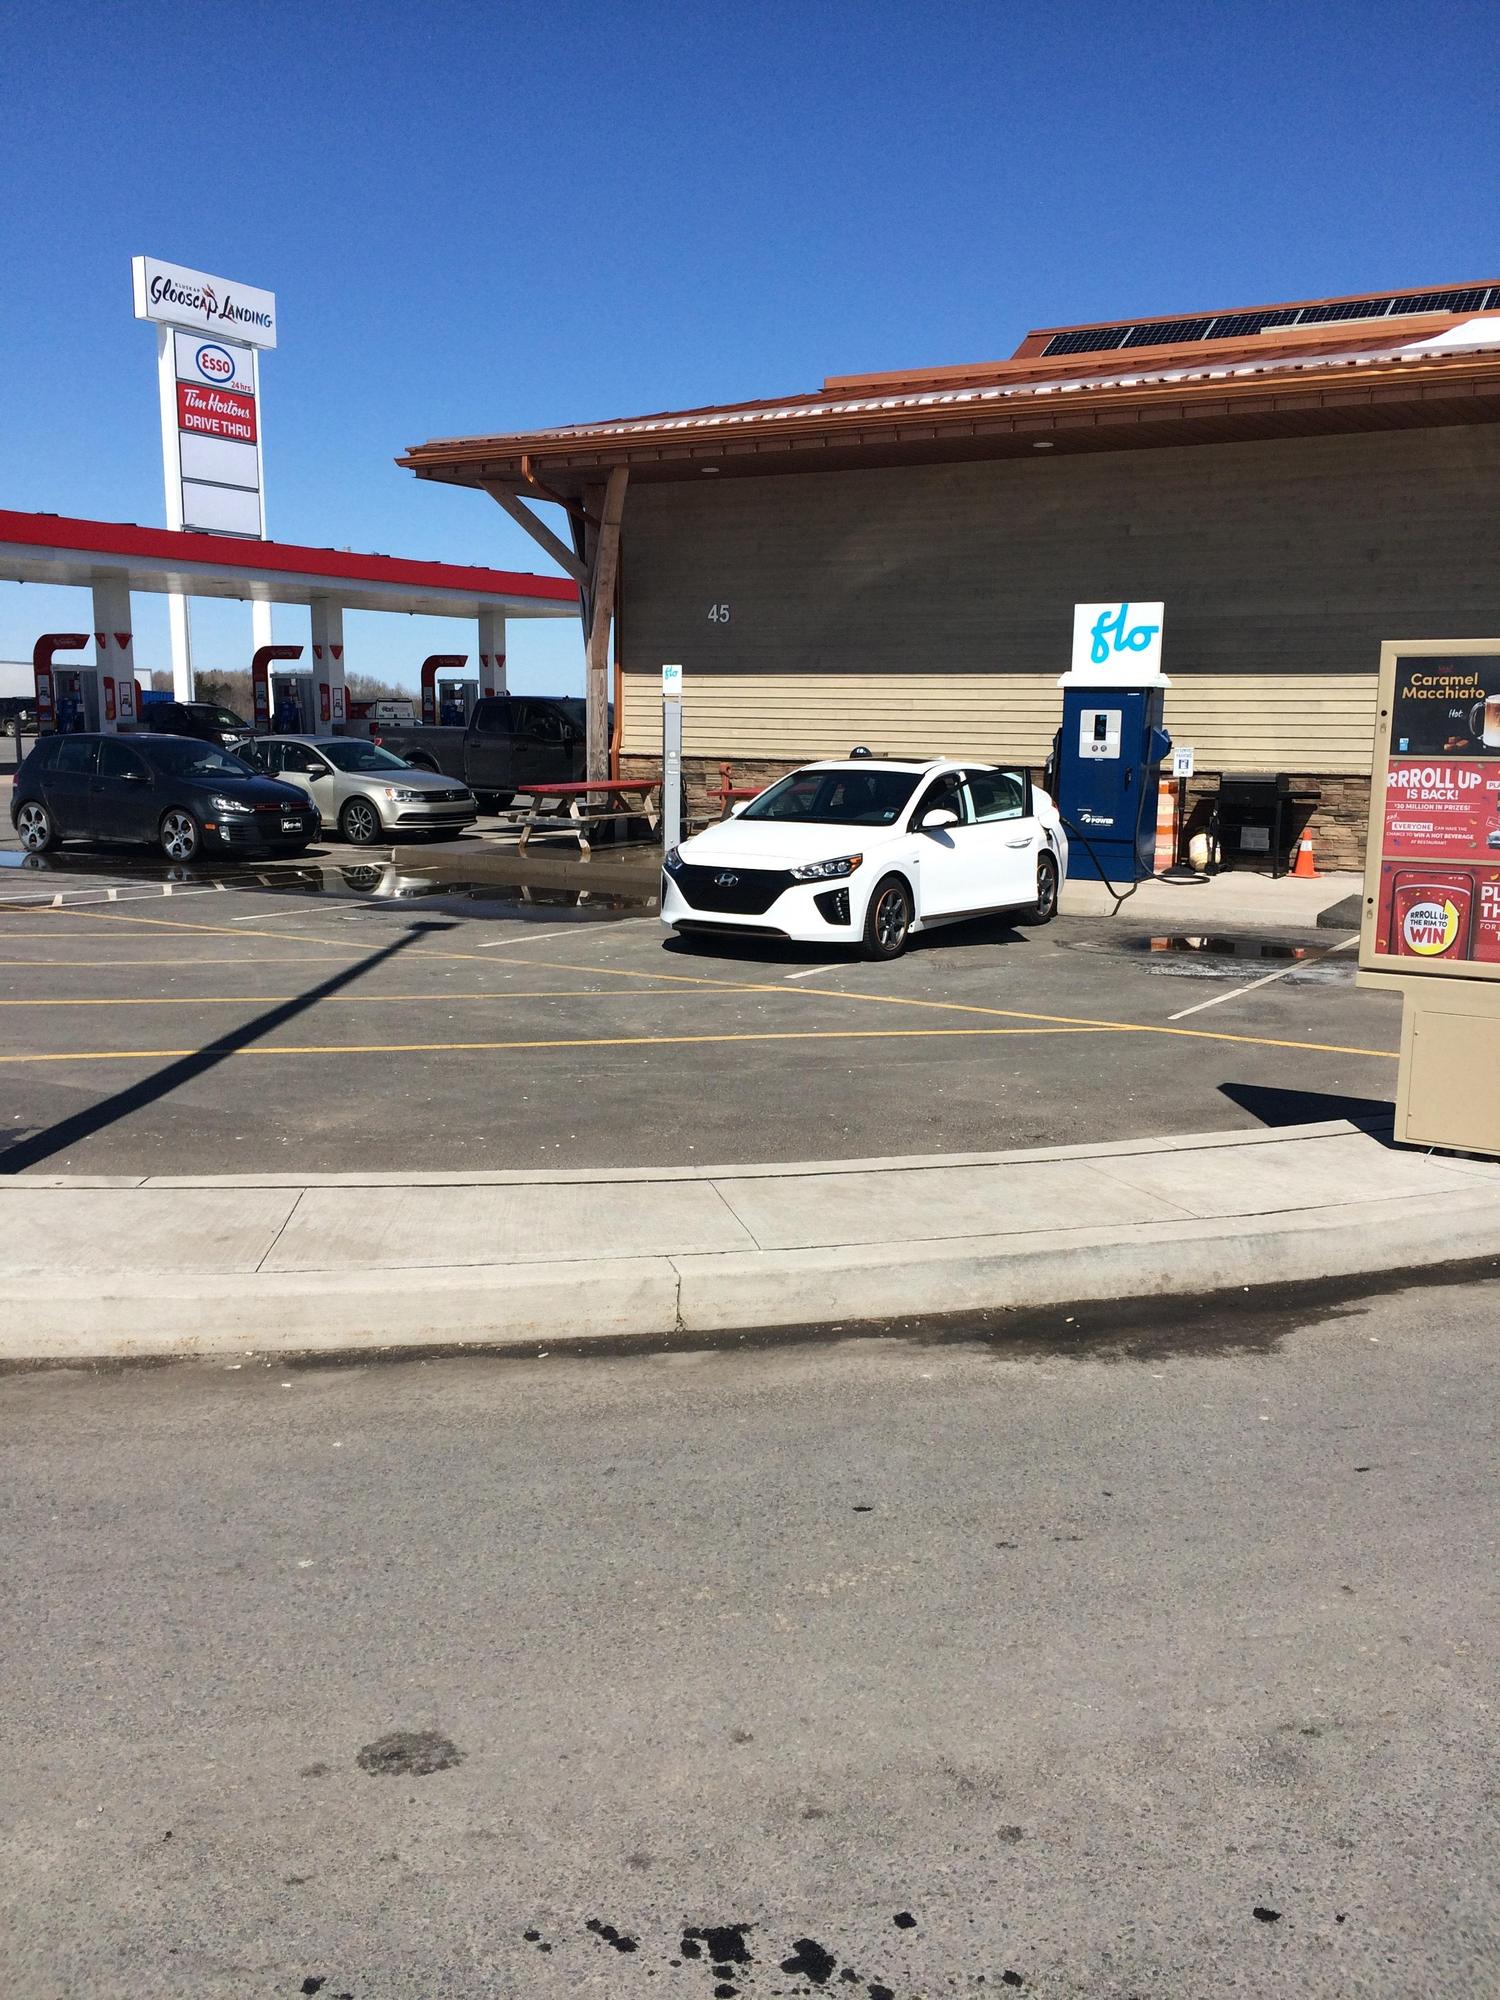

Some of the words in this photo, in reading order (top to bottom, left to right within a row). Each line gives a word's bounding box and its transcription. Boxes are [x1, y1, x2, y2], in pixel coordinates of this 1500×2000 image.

[231, 381, 239, 389] 24
[240, 383, 252, 392] hrs
[183, 389, 206, 410] Tim
[207, 393, 250, 419] Hortons
[185, 413, 220, 432] DRIVE
[221, 420, 251, 438] THRU
[707, 604, 730, 623] 45
[1090, 602, 1160, 664] flo
[664, 665, 679, 680] flo
[1410, 672, 1479, 686] Caramel
[1402, 686, 1486, 699] Macchiato
[1448, 708, 1464, 719] Hot
[1387, 767, 1455, 789] RRROLL
[1458, 769, 1482, 789] UP
[1406, 789, 1418, 799] IS
[1421, 789, 1459, 800] BACK!
[1393, 823, 1432, 831] EVERYONE
[1410, 910, 1438, 920] RRROLL
[1439, 912, 1449, 921] UP
[1409, 926, 1446, 945] WIN
